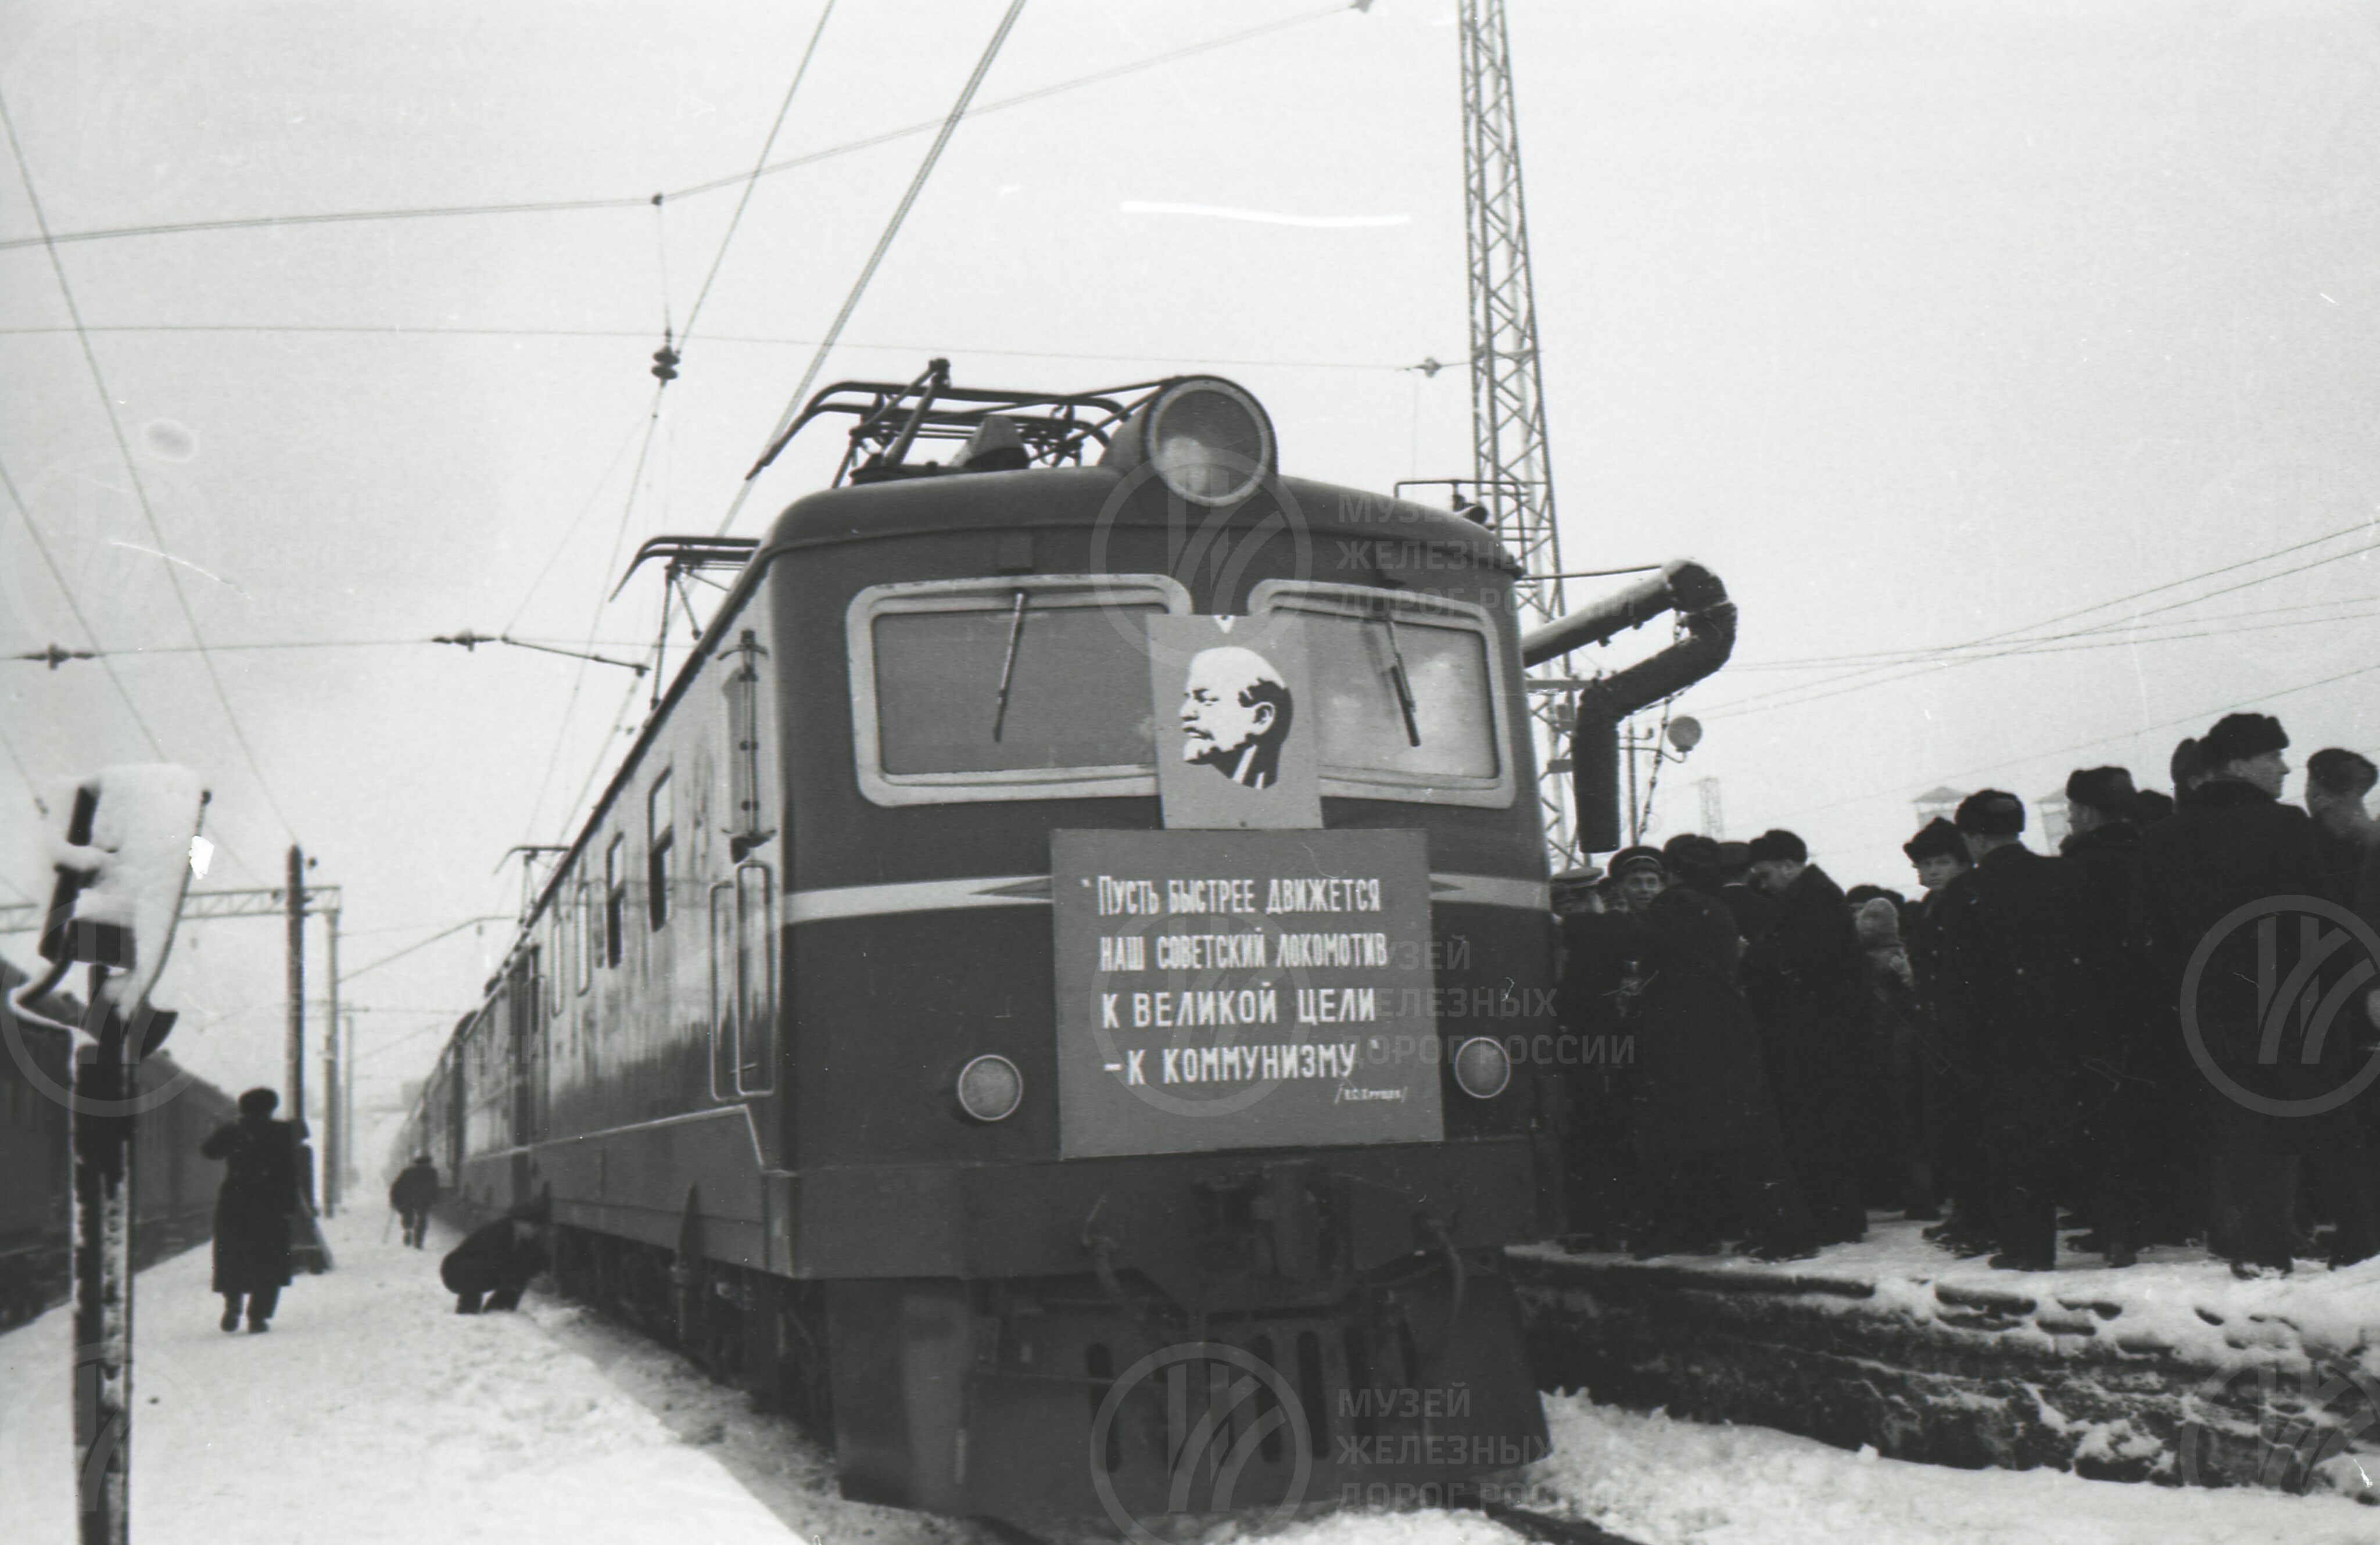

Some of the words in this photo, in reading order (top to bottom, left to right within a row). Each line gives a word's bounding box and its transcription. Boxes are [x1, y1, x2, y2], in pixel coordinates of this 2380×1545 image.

[1167, 879, 1256, 913] БЫСТРЕЕ
[1266, 879, 1381, 915] ДВИЖЕТСЯ
[1101, 936, 1145, 971] НАШ
[1156, 927, 1266, 970] СОВЕТСКИЙ
[1276, 933, 1388, 967] ЛОКОМОТИВ
[1102, 993, 1120, 1028] К
[1132, 981, 1277, 1028] ВЕЛИКОЙ
[1297, 988, 1375, 1026] ЦЕЛИ
